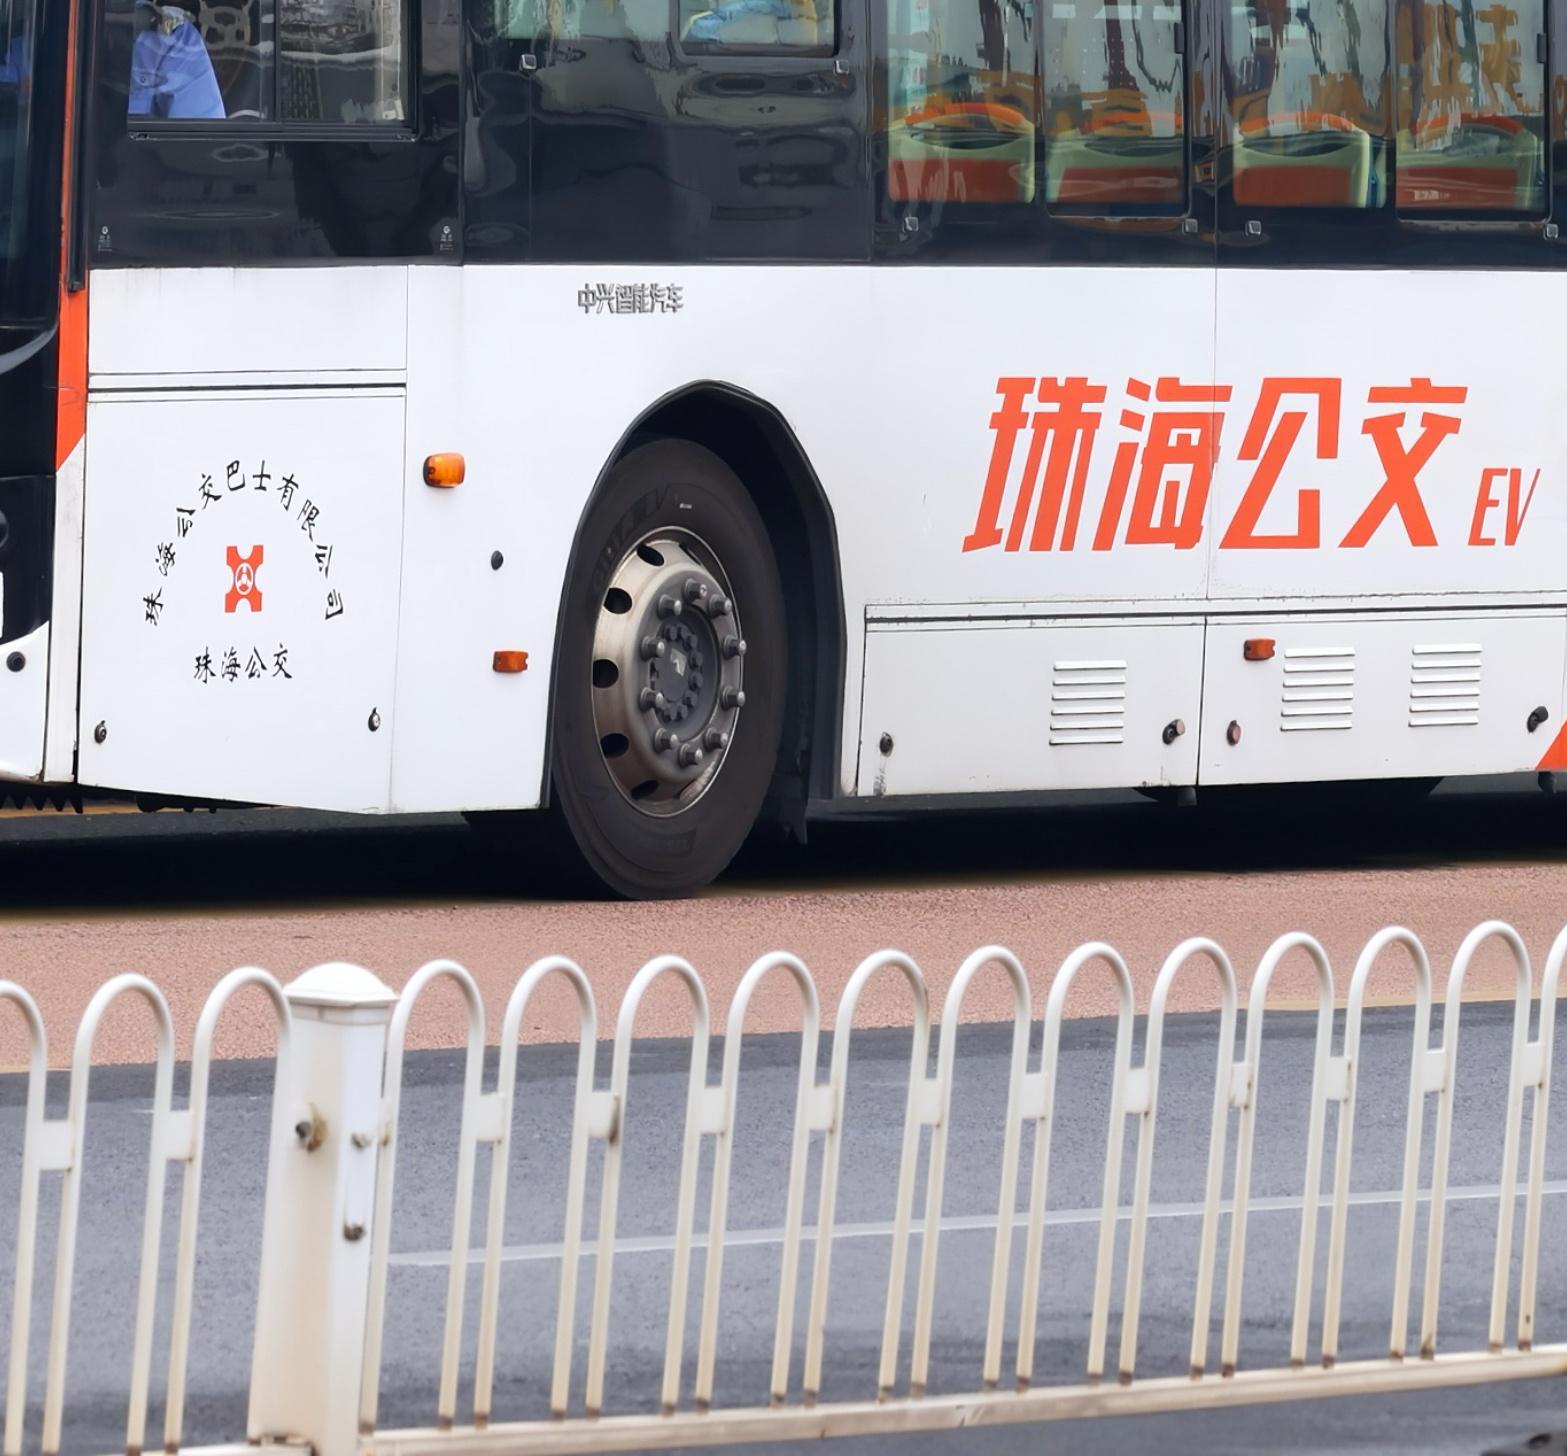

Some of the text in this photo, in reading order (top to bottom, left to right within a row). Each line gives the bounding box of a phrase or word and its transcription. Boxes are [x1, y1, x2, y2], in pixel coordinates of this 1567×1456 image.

[577, 282, 684, 314] 中兴智能汽车
[961, 376, 1542, 553] 珠海公交 EV
[142, 459, 345, 626] 珠海公交巴士有限公司
[193, 642, 293, 685] 珠海公交
